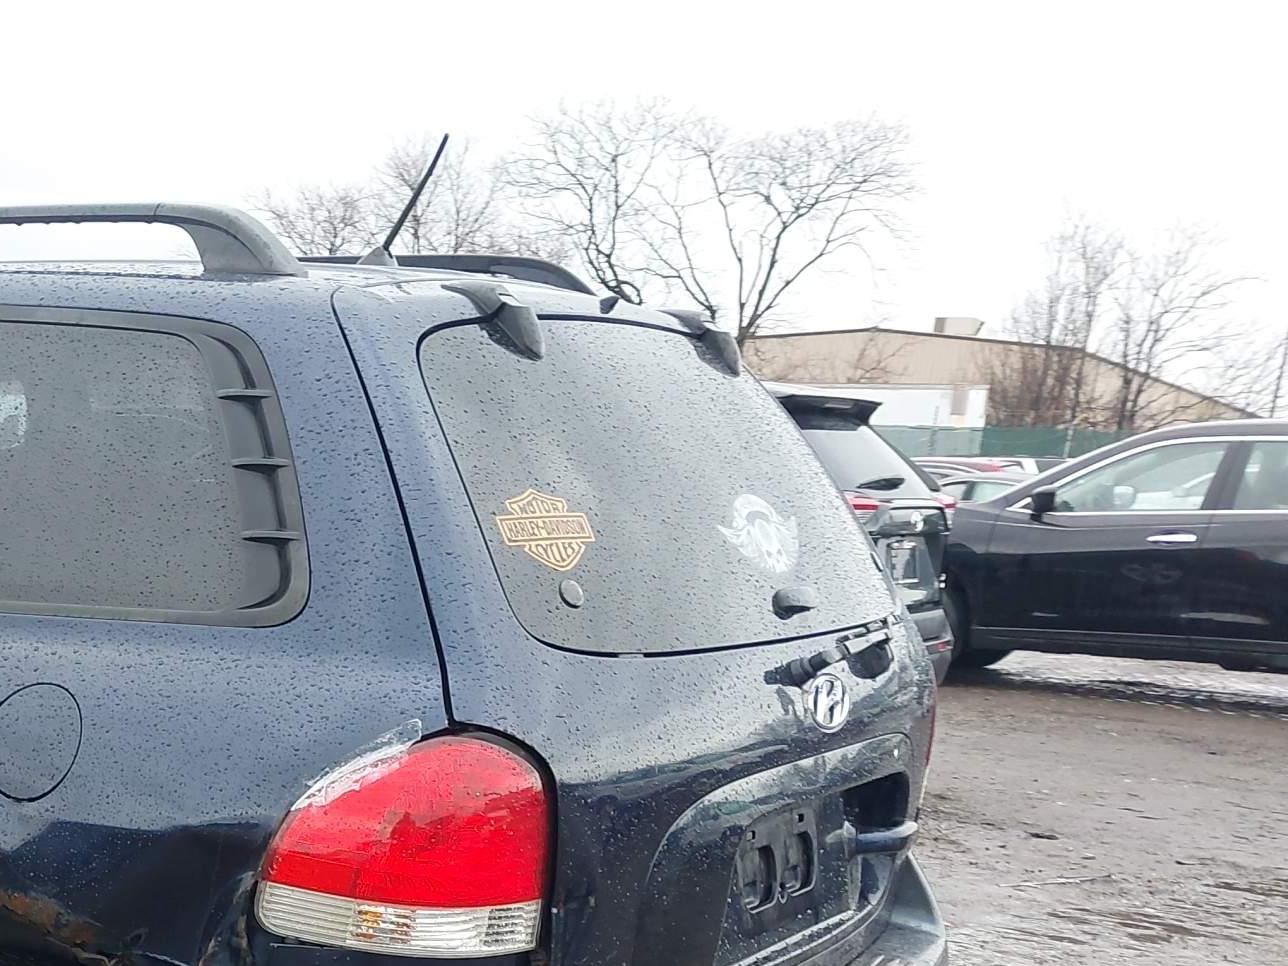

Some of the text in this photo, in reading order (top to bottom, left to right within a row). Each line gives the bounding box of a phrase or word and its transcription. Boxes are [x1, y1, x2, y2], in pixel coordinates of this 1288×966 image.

[516, 499, 561, 515] MOTOR
[504, 518, 587, 539] HARLEY-DAVIDSON
[535, 542, 576, 563] CYCLES
